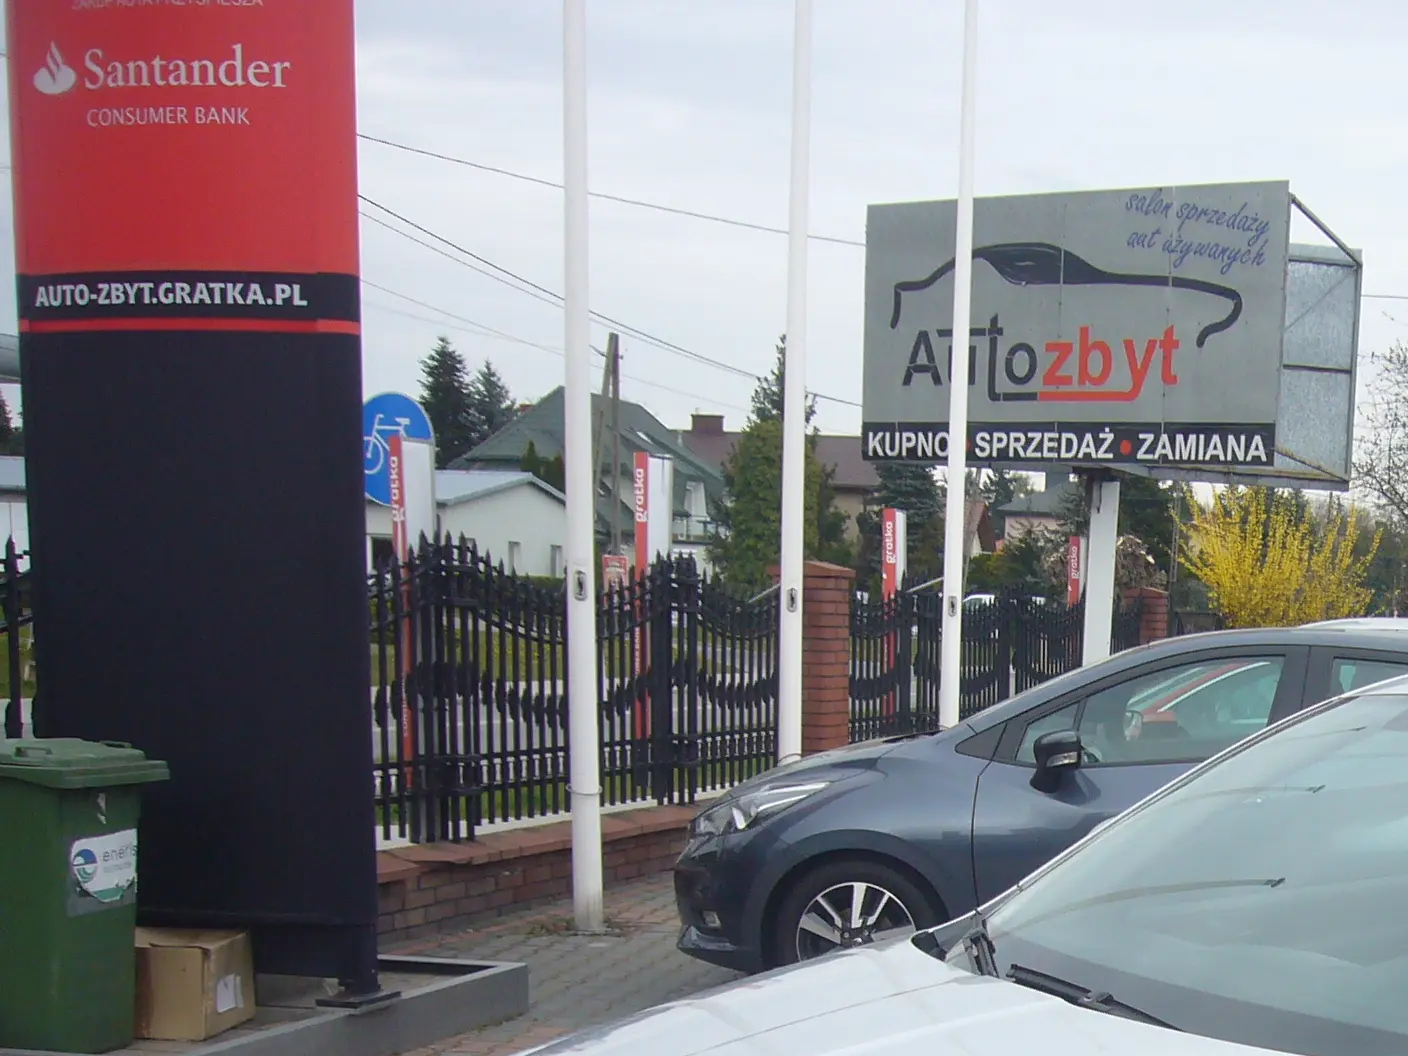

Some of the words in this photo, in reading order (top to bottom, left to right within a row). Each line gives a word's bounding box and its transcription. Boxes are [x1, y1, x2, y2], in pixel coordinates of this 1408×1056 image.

[84, 43, 291, 90] Santander
[86, 107, 188, 127] CONSUMER
[194, 106, 251, 126] BANK
[1125, 188, 1173, 219] salon
[1175, 202, 1270, 246] sprzedaży
[1126, 227, 1162, 249] aut
[1162, 234, 1269, 275] używanych
[35, 281, 309, 308] AUTO-ZBYT.GRATKA.PL
[866, 431, 949, 458] KUPNO
[974, 427, 1114, 459] SPRZEDAŻ
[1136, 432, 1268, 463] ZAMIANA
[390, 456, 406, 522] gratka
[633, 468, 648, 522] gratka
[884, 521, 897, 564] gratka
